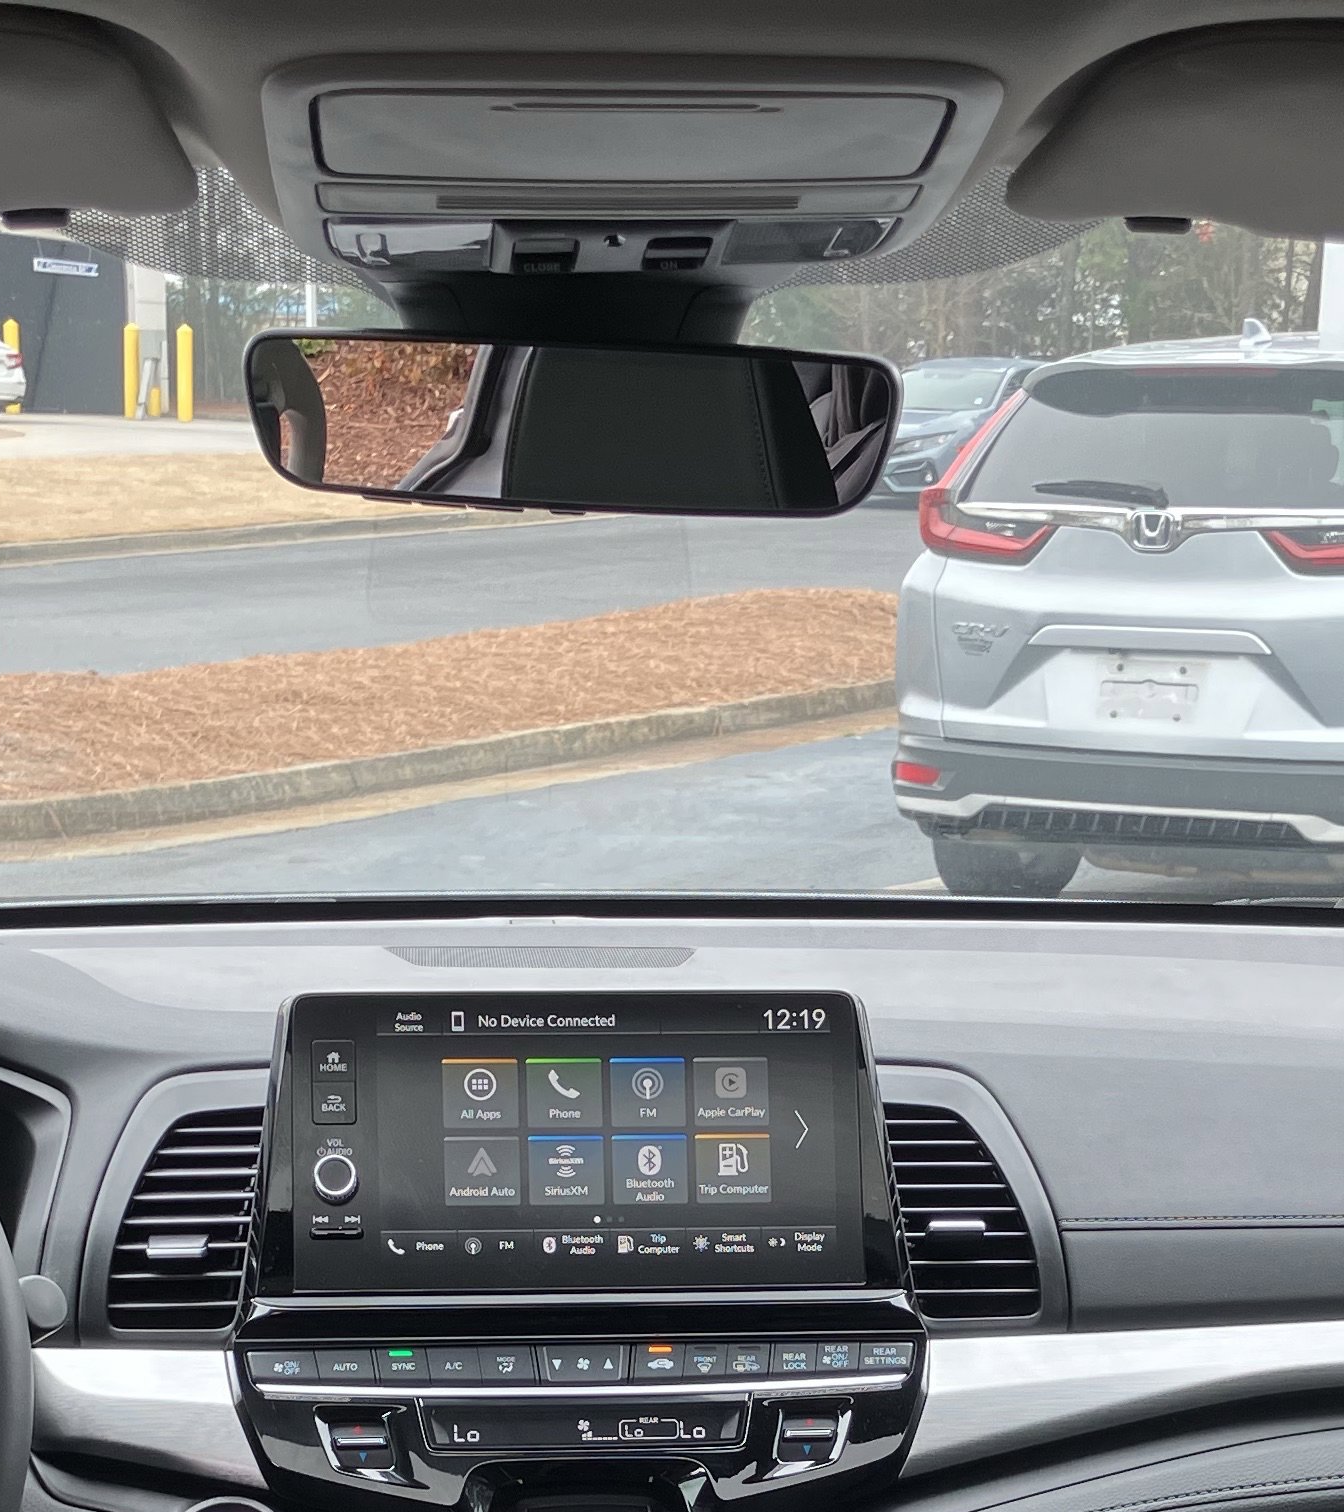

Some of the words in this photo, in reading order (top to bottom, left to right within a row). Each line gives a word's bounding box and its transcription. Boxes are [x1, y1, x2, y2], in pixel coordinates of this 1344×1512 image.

[395, 1011, 422, 1022] Audio
[478, 1015, 497, 1027] No
[500, 1015, 544, 1027] Device
[546, 1014, 616, 1028] Connected
[763, 1008, 826, 1030] 12:19
[394, 1023, 424, 1033] Source
[319, 1063, 348, 1073] HOME
[321, 1103, 346, 1113] BACK
[639, 1108, 657, 1118] FM
[697, 1107, 726, 1120] Apple
[728, 1106, 766, 1120] CarPlay
[460, 1109, 474, 1119] All
[475, 1109, 502, 1121] Apps
[549, 1108, 581, 1119] Phone
[327, 1139, 344, 1147] VOL
[327, 1148, 353, 1156] AUDIO
[626, 1177, 674, 1189] Bluetooth
[449, 1186, 488, 1197] Android
[490, 1186, 515, 1197] Auto
[544, 1186, 589, 1196] SiriusXM
[698, 1184, 718, 1196] Trip
[719, 1183, 769, 1196] Computer
[635, 1191, 665, 1202] Audio
[561, 1234, 604, 1244] Bluetooth
[650, 1233, 667, 1245] Trip
[721, 1232, 747, 1242] Smart
[794, 1231, 825, 1243] Display
[416, 1241, 444, 1251] Phone
[499, 1240, 514, 1250] FM
[569, 1245, 596, 1255] Audio
[638, 1244, 680, 1256] Computer
[714, 1243, 755, 1253] Shortcuts
[797, 1242, 823, 1252] Mode
[824, 1345, 849, 1354] REAR
[873, 1348, 897, 1356] REAR
[496, 1356, 516, 1364] MODE
[694, 1356, 717, 1364] FRONT
[737, 1355, 756, 1363] REAR
[782, 1353, 806, 1361] REAR
[864, 1356, 907, 1366] SETTINGS
[333, 1362, 358, 1371] AUTO
[391, 1362, 416, 1371] SYNC
[444, 1361, 463, 1371] A/C
[783, 1361, 806, 1370] LOCK
[831, 1360, 850, 1369] OFF
[283, 1367, 301, 1375] OFF
[453, 1424, 480, 1442] Lo
[624, 1425, 644, 1438] Lo
[680, 1421, 706, 1439] Lo
